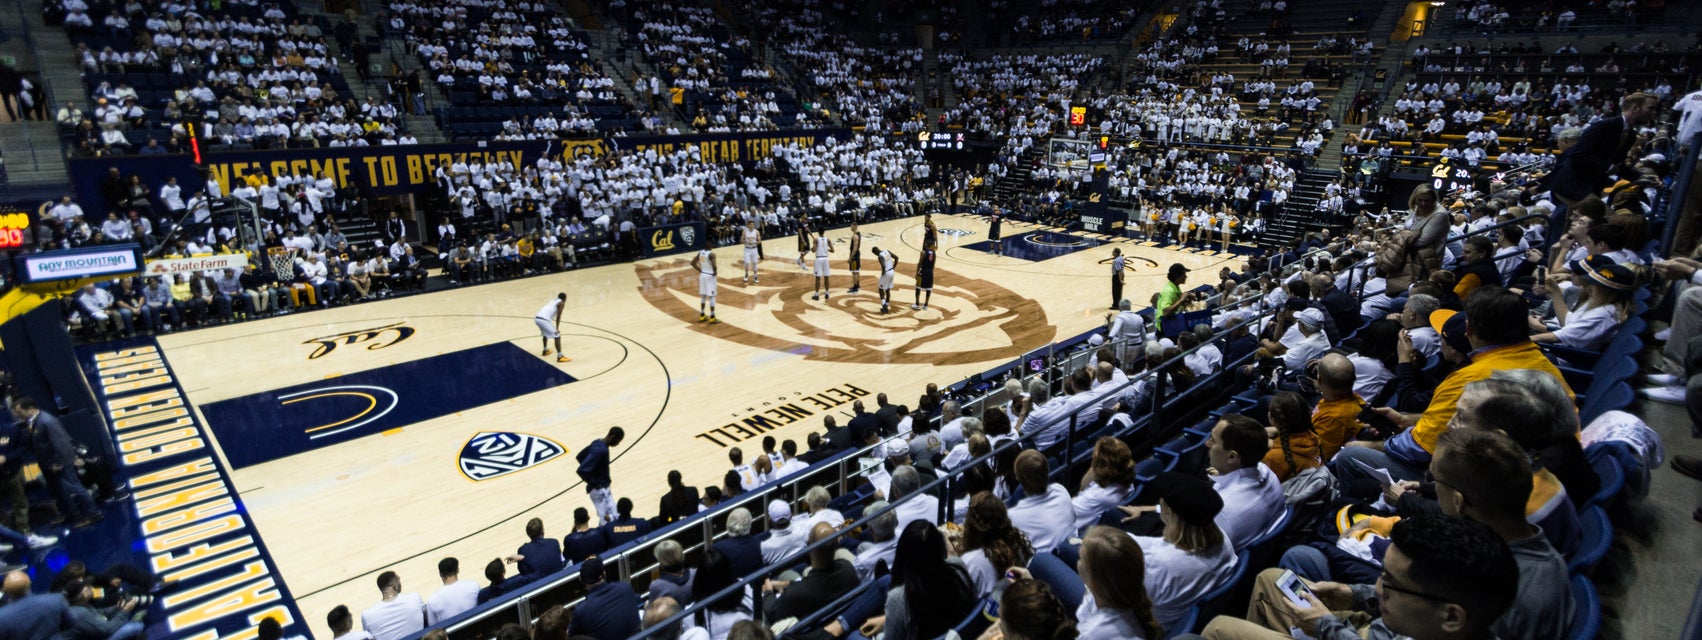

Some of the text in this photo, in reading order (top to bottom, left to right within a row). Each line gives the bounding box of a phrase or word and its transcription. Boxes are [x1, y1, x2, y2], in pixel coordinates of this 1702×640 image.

[700, 139, 739, 164] BEAR
[746, 136, 815, 161] TERRTRY
[208, 157, 350, 198] WECOME
[363, 155, 398, 187] TO
[1431, 164, 1451, 178] Cal
[1433, 178, 1443, 190] 0
[1081, 215, 1103, 225] MUSCLE
[1084, 222, 1098, 231] MILK
[651, 229, 676, 251] Cal
[301, 321, 416, 360] Cal
[694, 383, 872, 448] PETE NEWELL
[731, 391, 802, 417] COURT
[95, 345, 295, 640] CALIFORNIA GOLDEN BEARS
